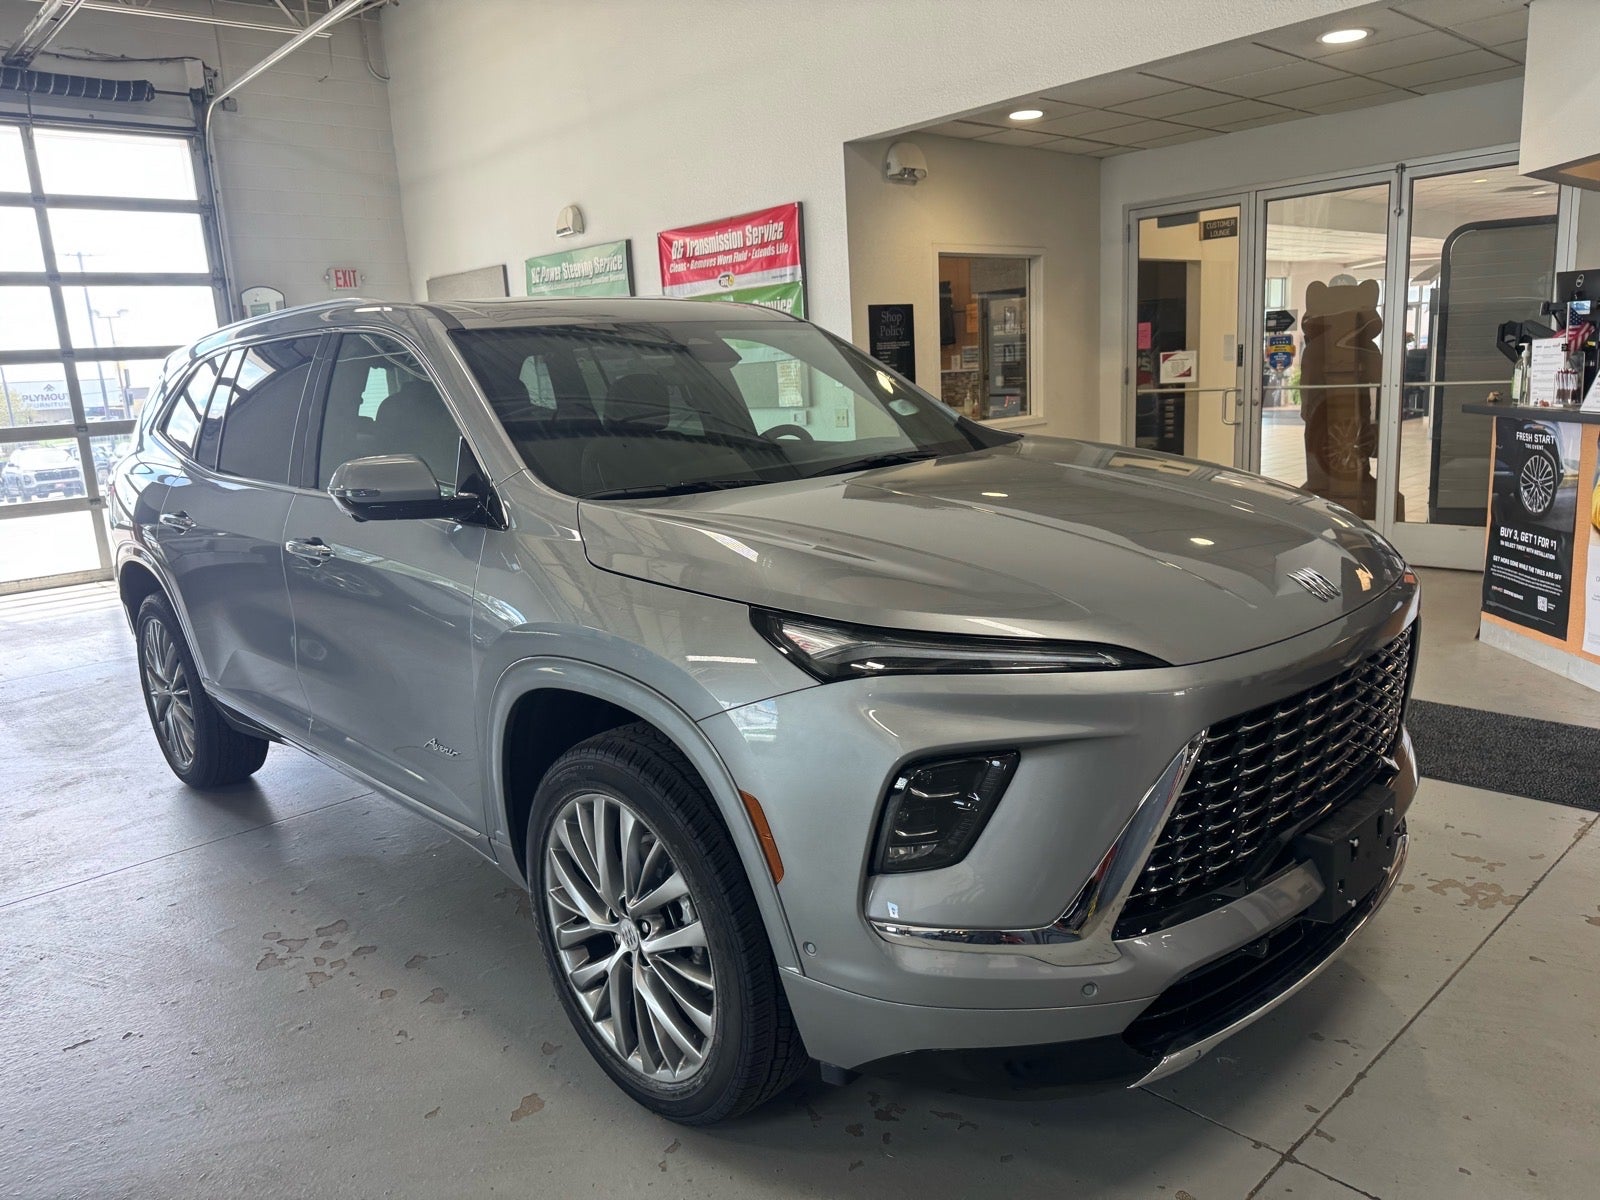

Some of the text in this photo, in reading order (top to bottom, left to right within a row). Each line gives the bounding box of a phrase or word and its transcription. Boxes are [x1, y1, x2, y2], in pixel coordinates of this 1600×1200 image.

[1206, 219, 1235, 230] CUSTOMER
[685, 229, 744, 257] Transmission
[745, 220, 784, 247] Service
[1210, 229, 1230, 238] LOUNGE
[669, 242, 789, 273] Cleans Removes Worn Fluid Extends Life
[540, 265, 561, 282] Power
[562, 258, 594, 279] Steering
[593, 252, 623, 274] Service
[334, 269, 357, 288] EXIT
[752, 296, 793, 314] vice
[881, 310, 903, 326] Shop
[880, 325, 905, 340] Policy
[1516, 432, 1555, 445] FRESH START
[1500, 527, 1513, 539] BUY
[1514, 530, 1519, 542] 3,
[1520, 532, 1533, 544] GET
[1534, 535, 1537, 545] 1
[1537, 535, 1550, 548] FOR
[1534, 568, 1545, 576] TIRES
